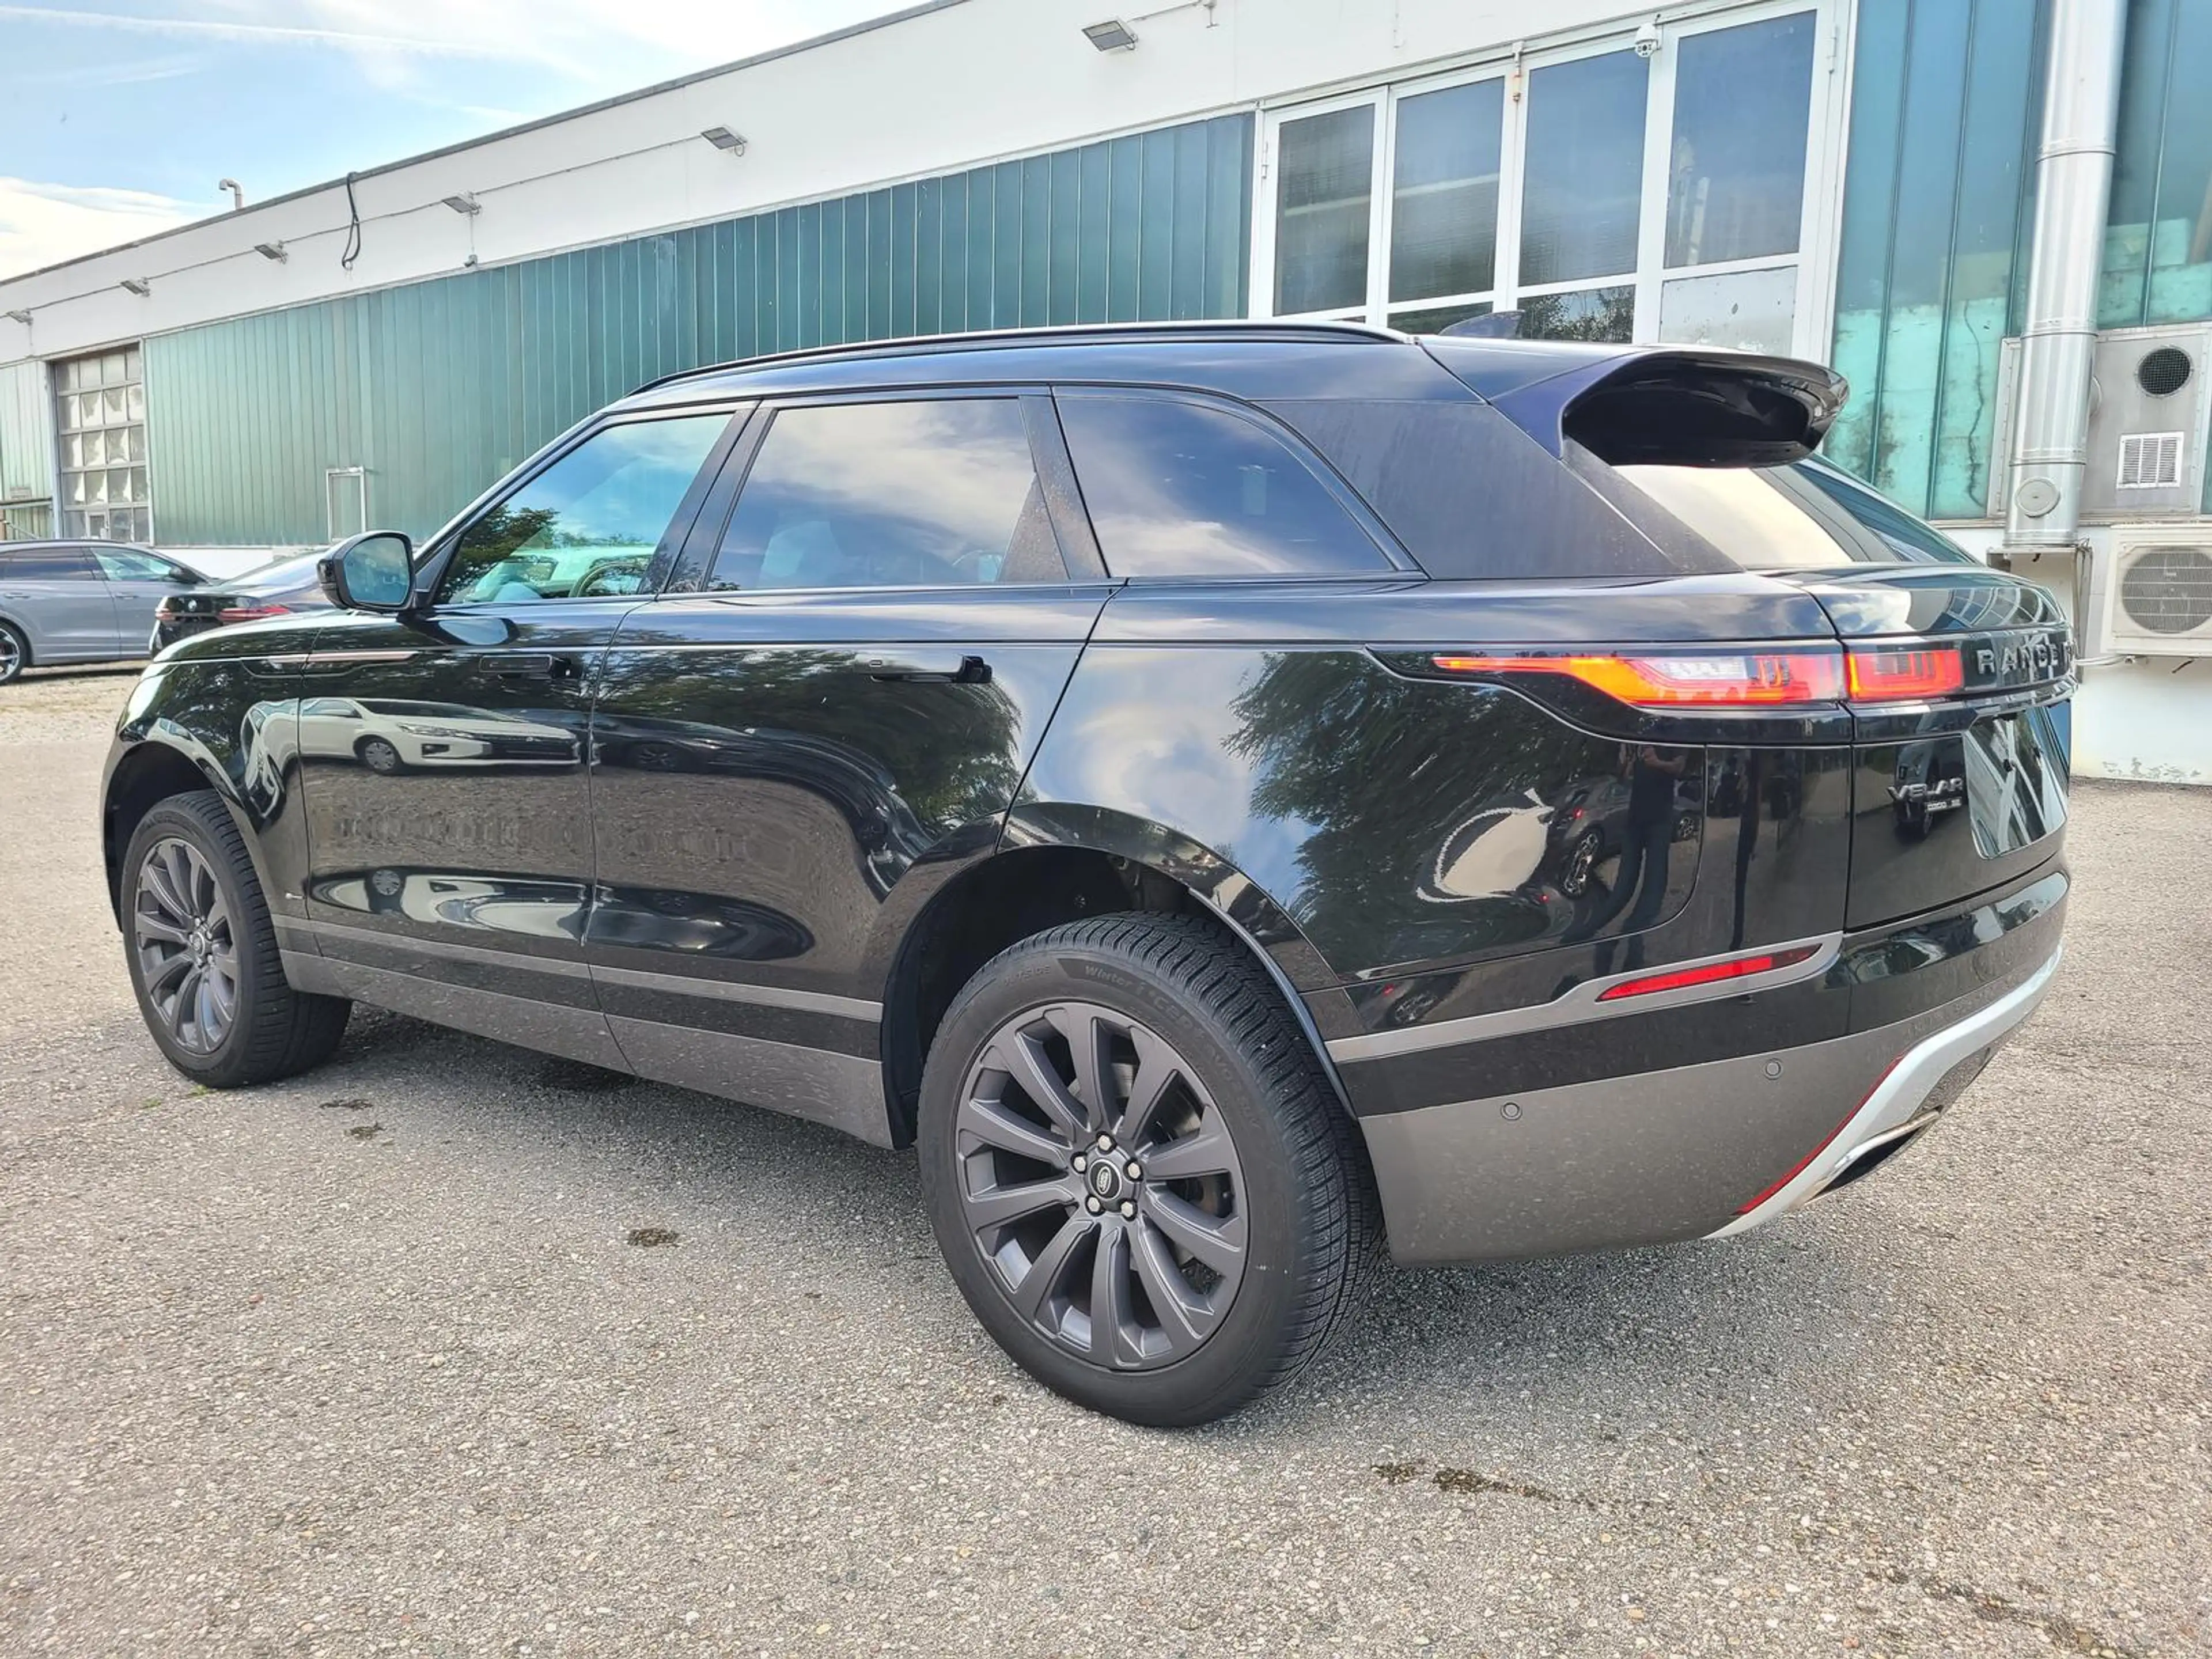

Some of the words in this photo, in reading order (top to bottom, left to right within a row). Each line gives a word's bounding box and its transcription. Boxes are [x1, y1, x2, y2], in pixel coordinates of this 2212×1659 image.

[1976, 643, 2059, 675] RANGE
[1887, 778, 1963, 801] VELAR
[1085, 964, 1131, 988] Winter
